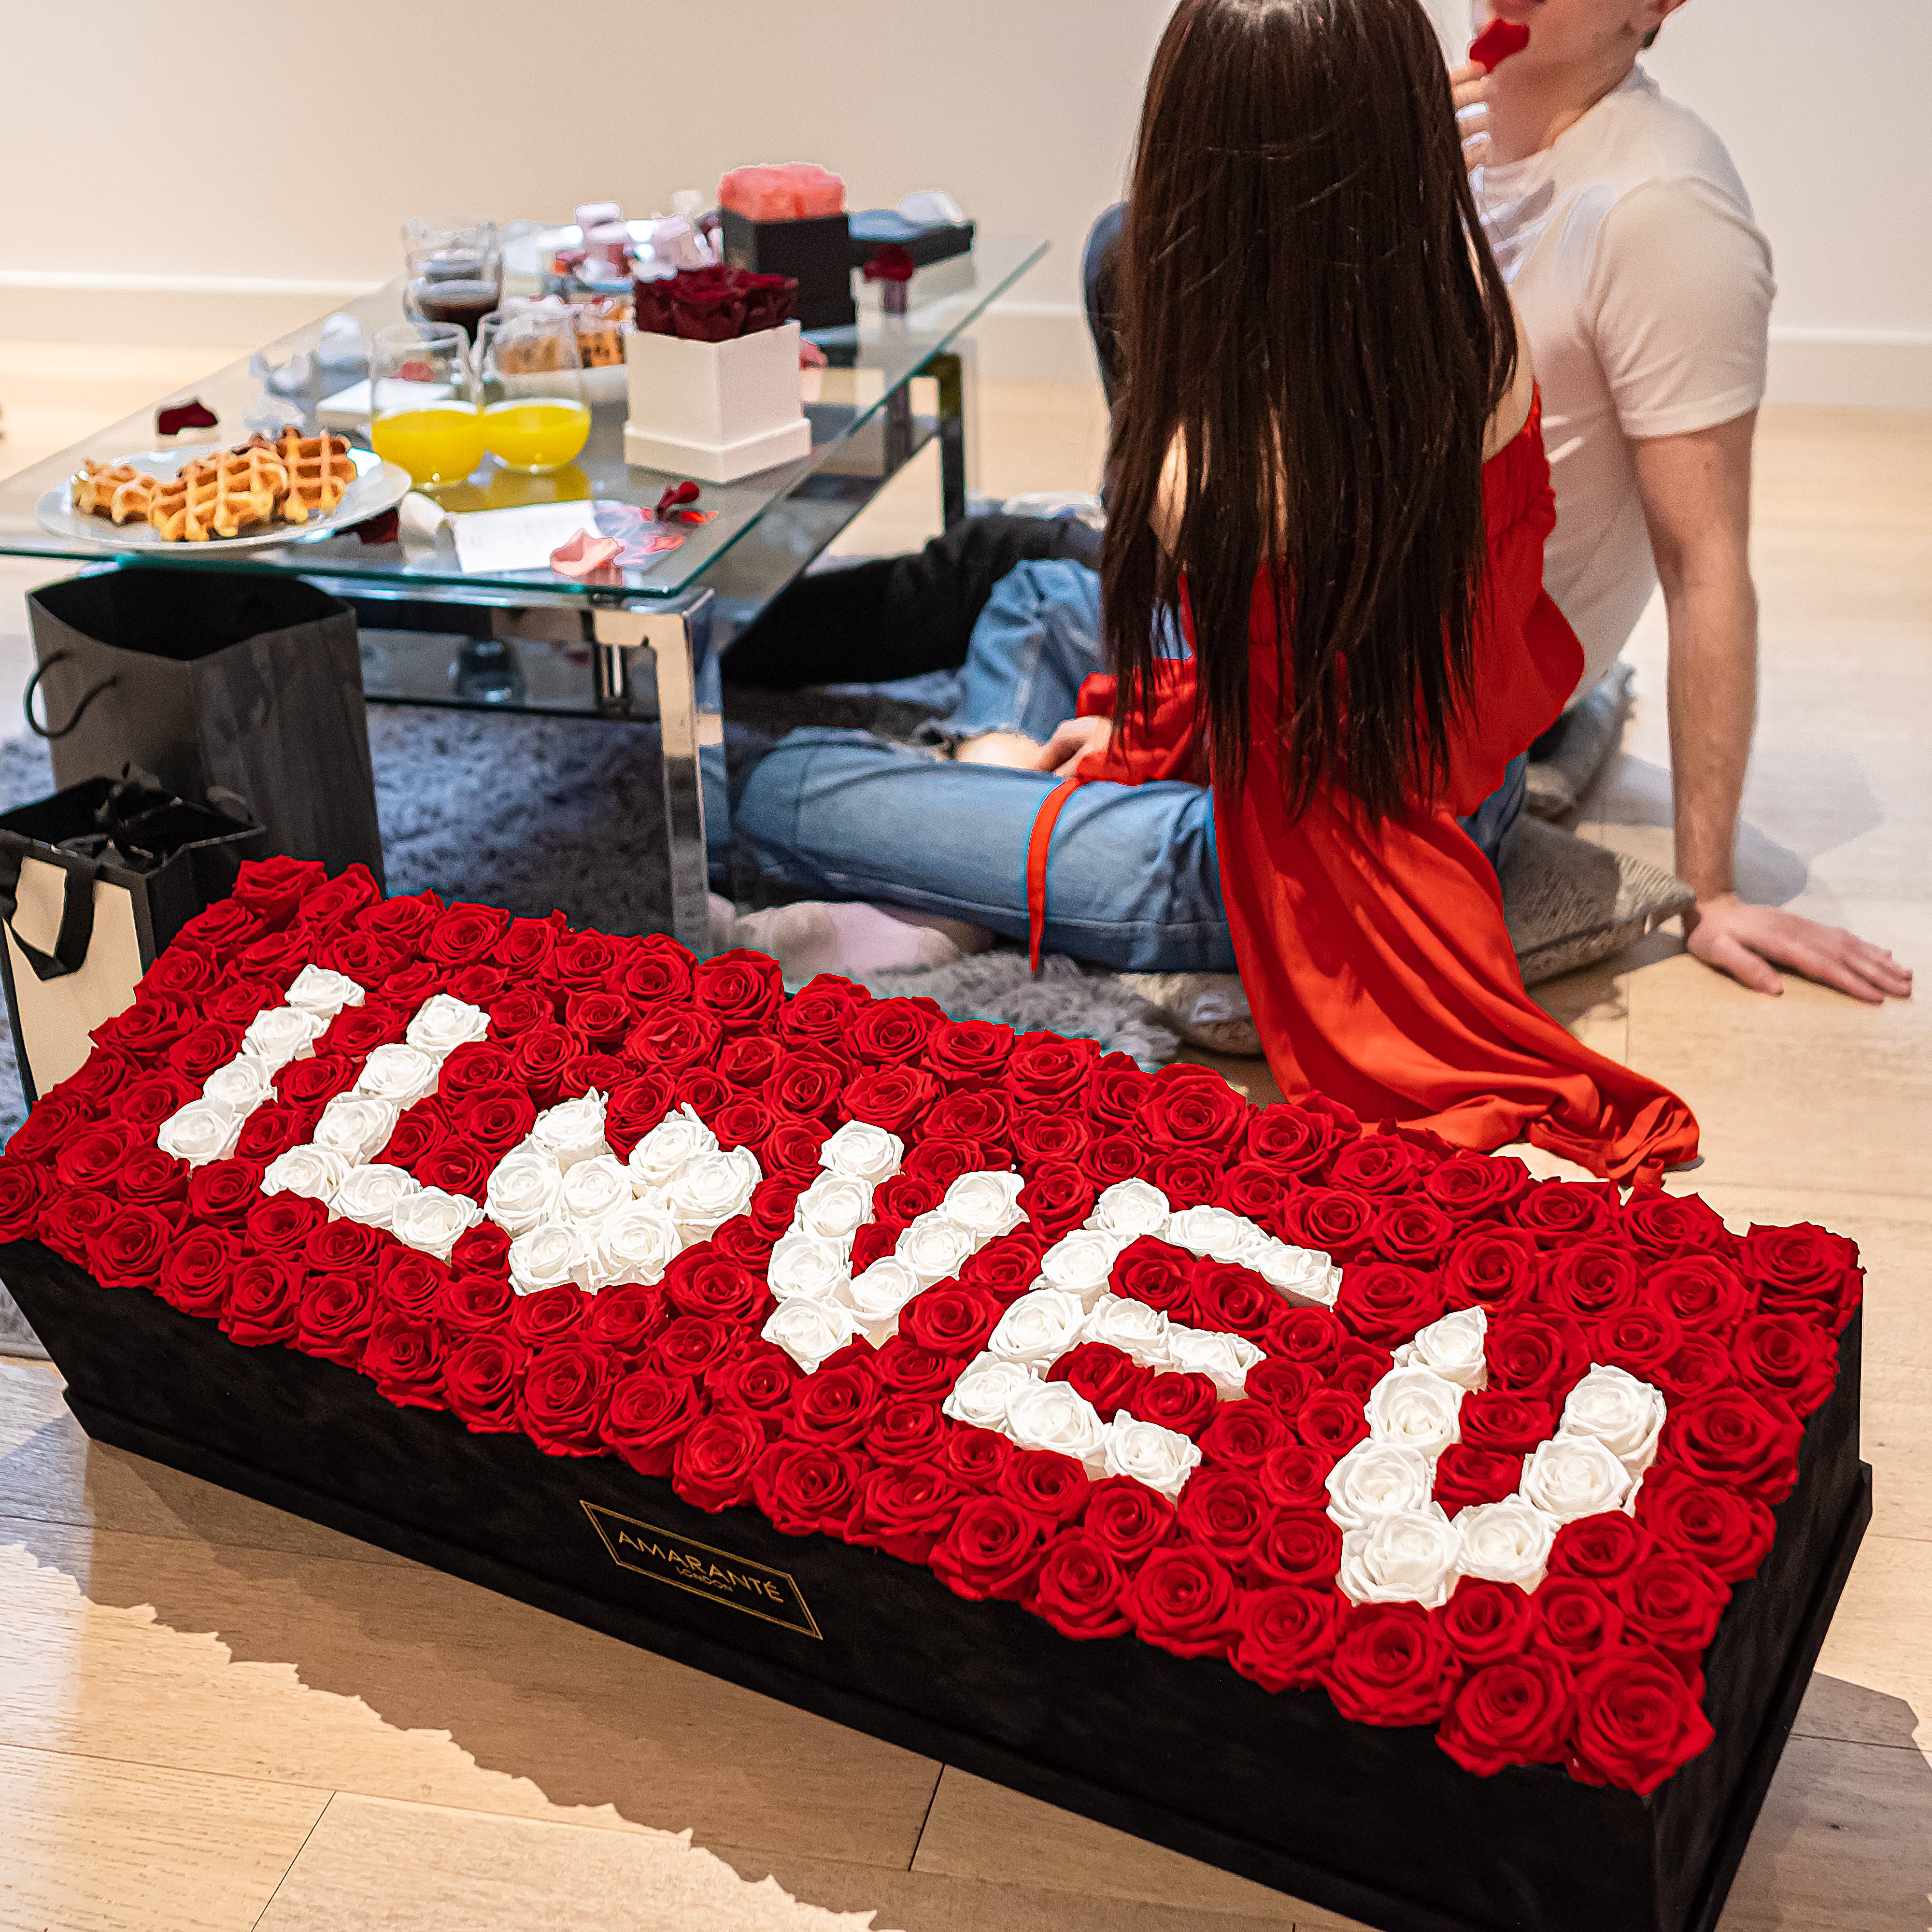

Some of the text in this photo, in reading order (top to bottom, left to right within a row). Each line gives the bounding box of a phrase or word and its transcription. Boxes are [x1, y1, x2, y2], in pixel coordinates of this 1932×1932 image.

[157, 964, 365, 1169] I
[1325, 1306, 1667, 1609] U
[676, 1566, 733, 1592] LONDON
